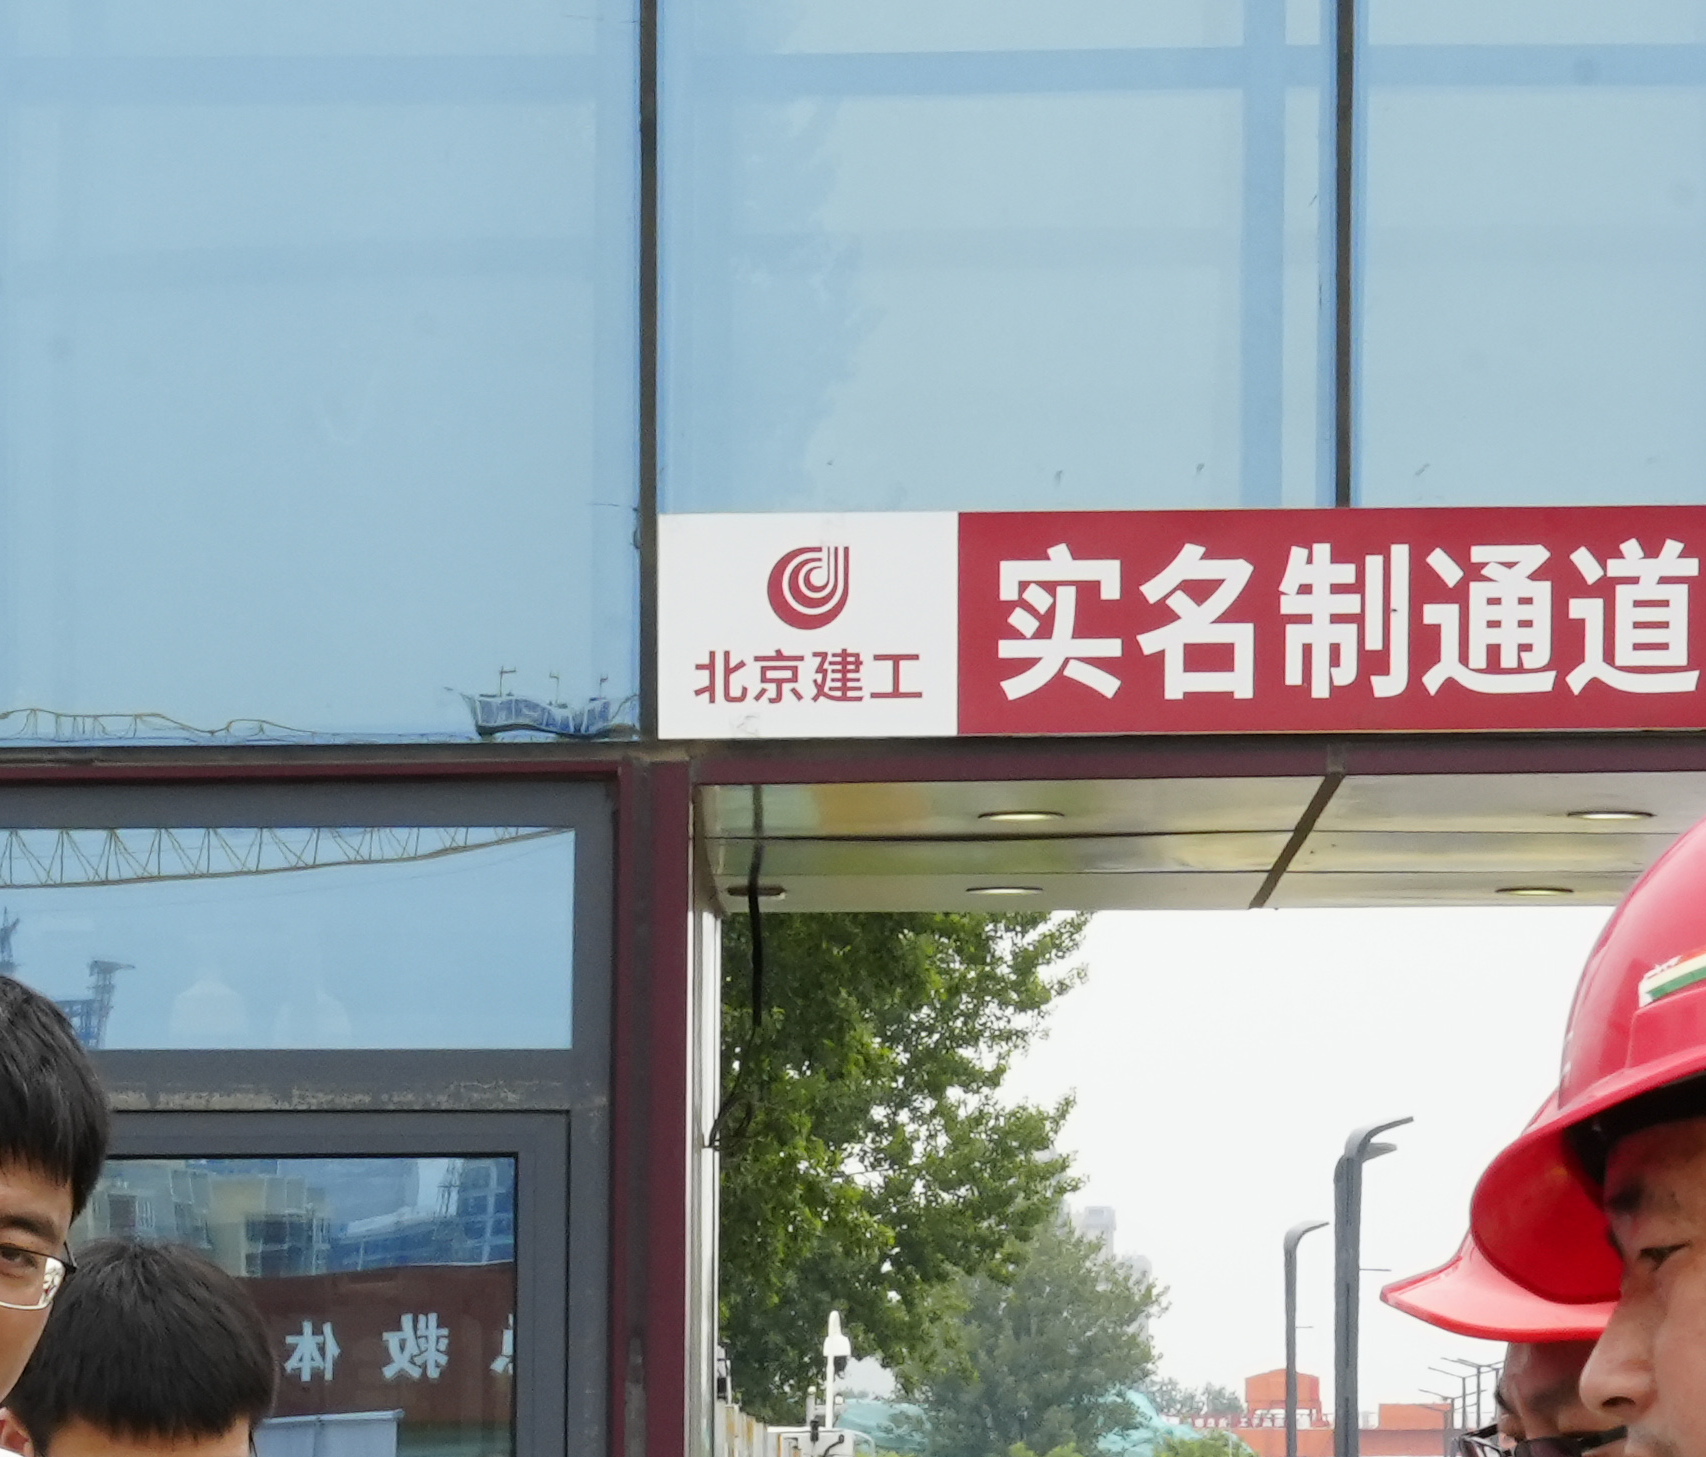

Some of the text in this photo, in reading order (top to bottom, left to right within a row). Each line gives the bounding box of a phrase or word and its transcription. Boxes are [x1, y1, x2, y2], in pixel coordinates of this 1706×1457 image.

[995, 538, 1701, 702] 实名制通道
[693, 647, 924, 704] 北京建工
